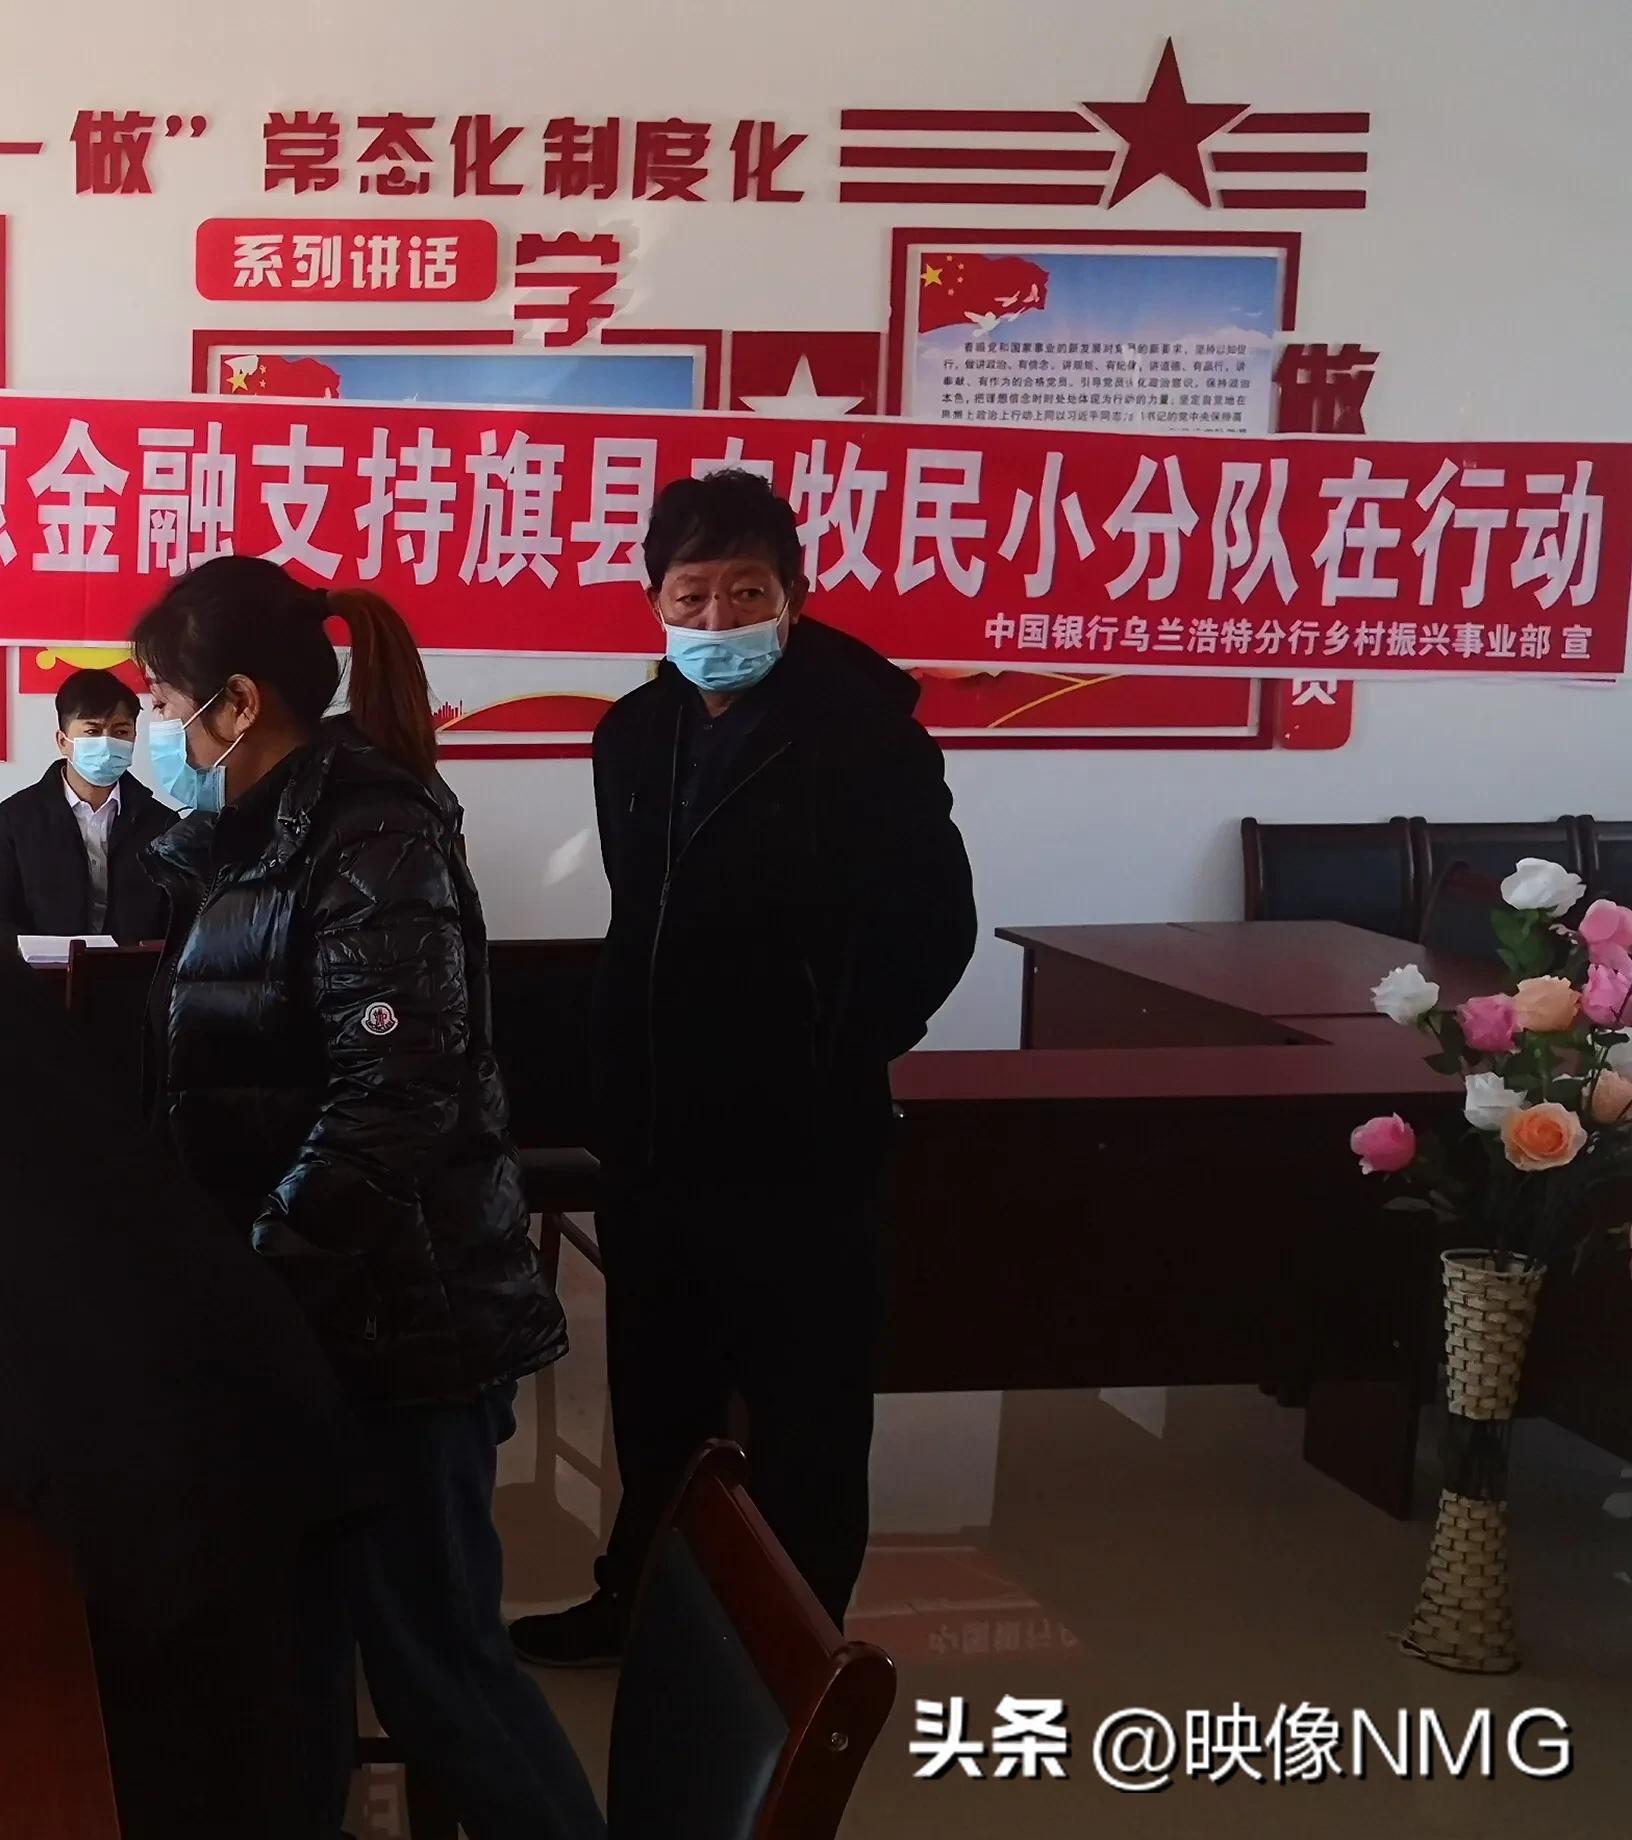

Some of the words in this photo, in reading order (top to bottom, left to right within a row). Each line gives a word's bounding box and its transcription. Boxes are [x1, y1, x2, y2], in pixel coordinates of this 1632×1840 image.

[262, 110, 809, 202] 常态化制度化
[232, 234, 460, 290] 系列讲话
[513, 231, 620, 347] 学
[1272, 343, 1381, 435] 做
[984, 612, 1553, 660] 中国银行乌兰浩特分行乡村振兴事业部
[1561, 622, 1592, 659] 宣
